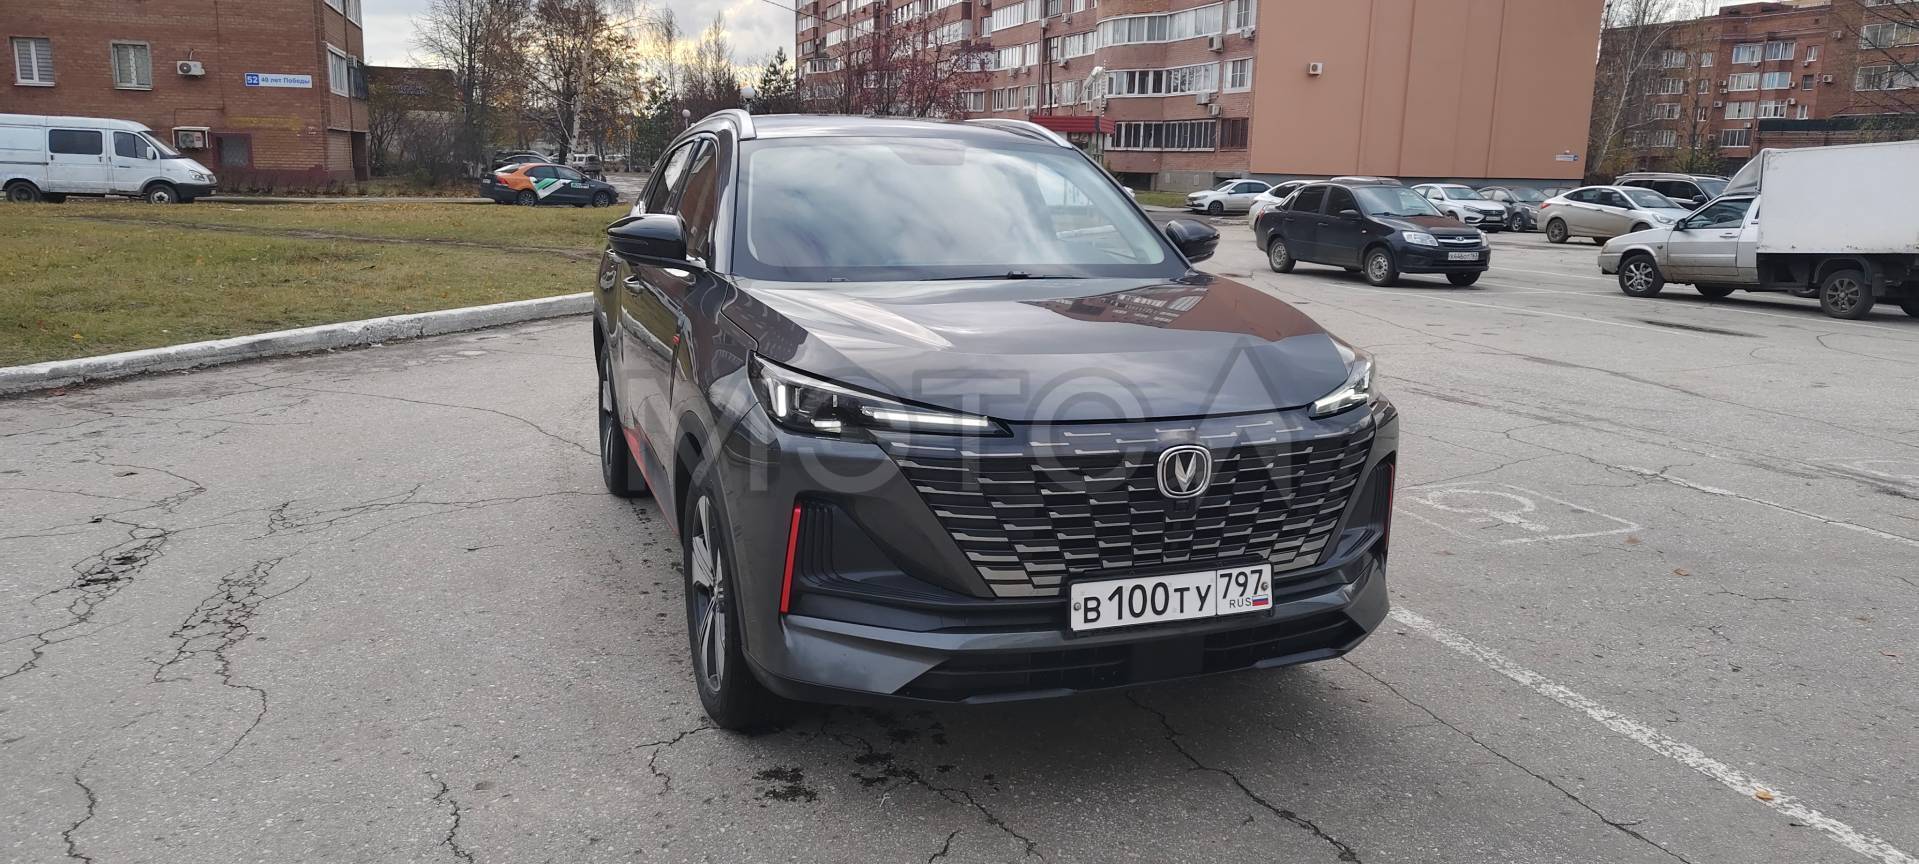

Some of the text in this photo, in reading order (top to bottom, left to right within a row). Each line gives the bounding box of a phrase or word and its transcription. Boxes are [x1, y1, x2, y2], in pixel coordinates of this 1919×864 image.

[247, 75, 258, 84] 52
[1219, 568, 1264, 600] 797
[1229, 598, 1252, 609] RUS
